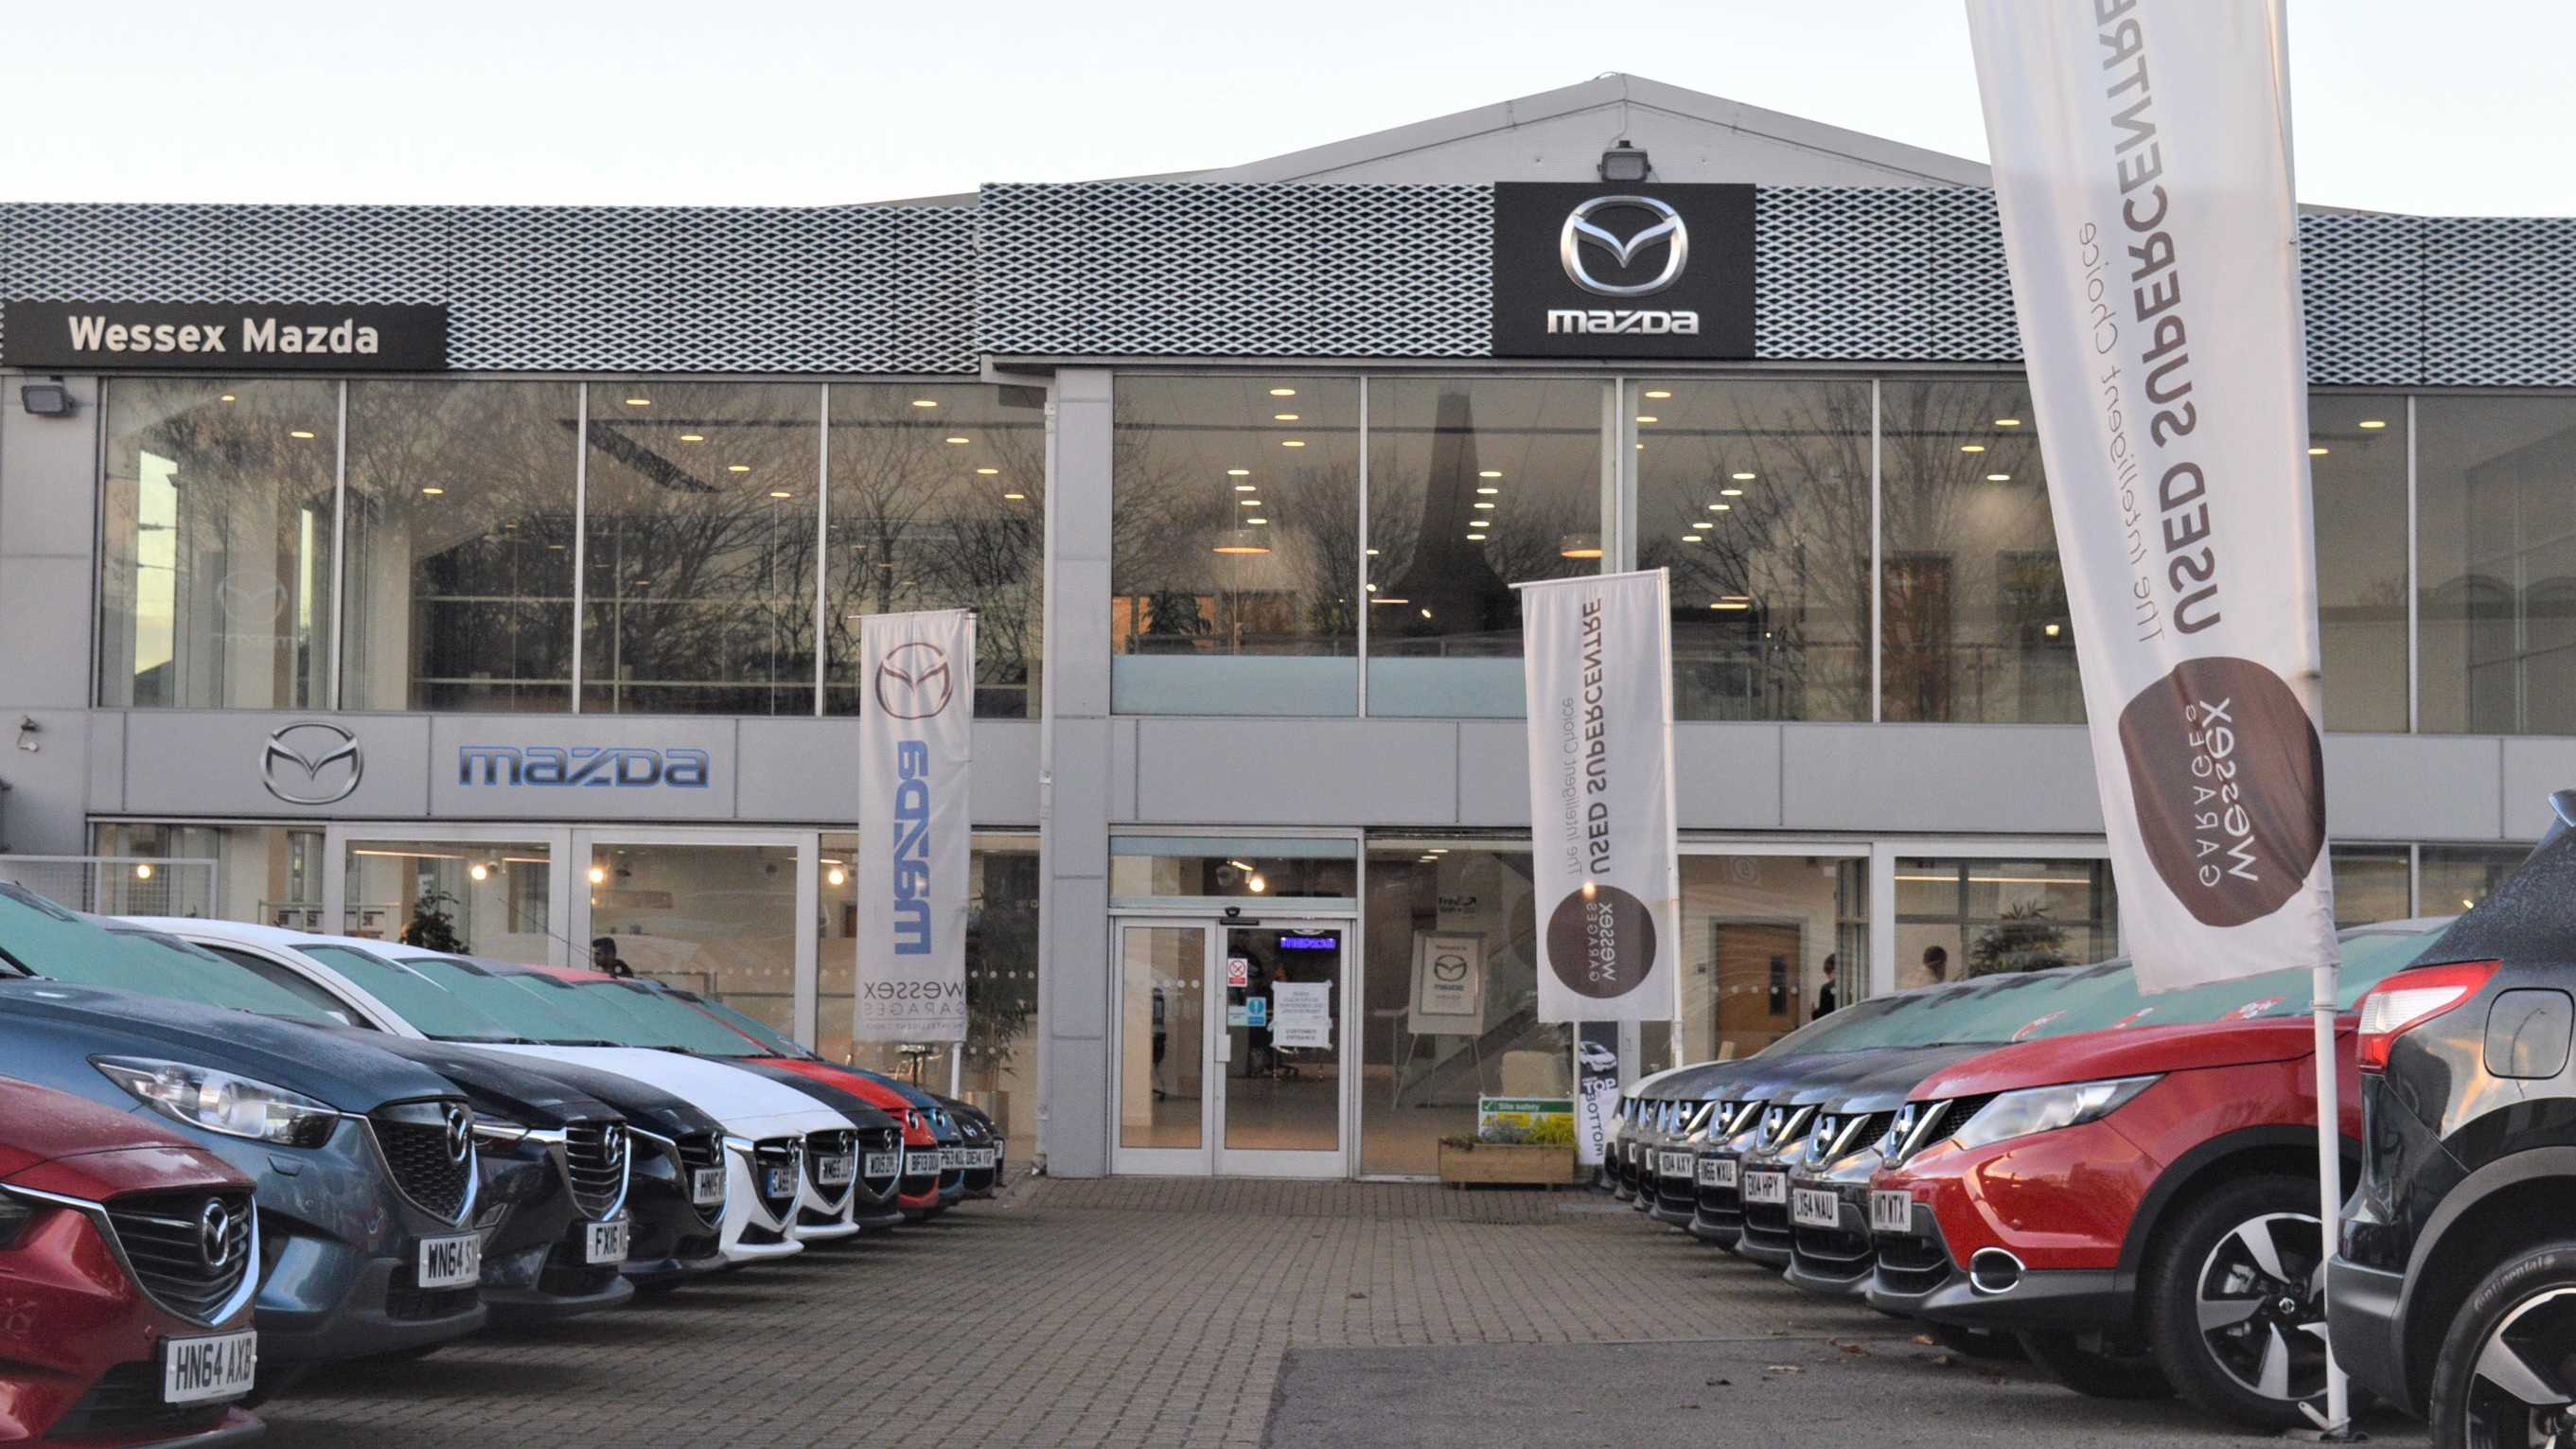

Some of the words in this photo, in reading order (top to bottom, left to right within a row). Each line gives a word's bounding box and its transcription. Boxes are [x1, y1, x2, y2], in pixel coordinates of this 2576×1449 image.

[68, 315, 226, 353] Wessex
[242, 318, 379, 354] Mazda
[1546, 309, 1700, 335] mazda
[458, 746, 710, 788] mazda
[1814, 1193, 1834, 1220] NAU
[427, 1239, 464, 1280] WN64
[175, 1340, 223, 1391] HN64
[226, 1336, 253, 1385] AXB
